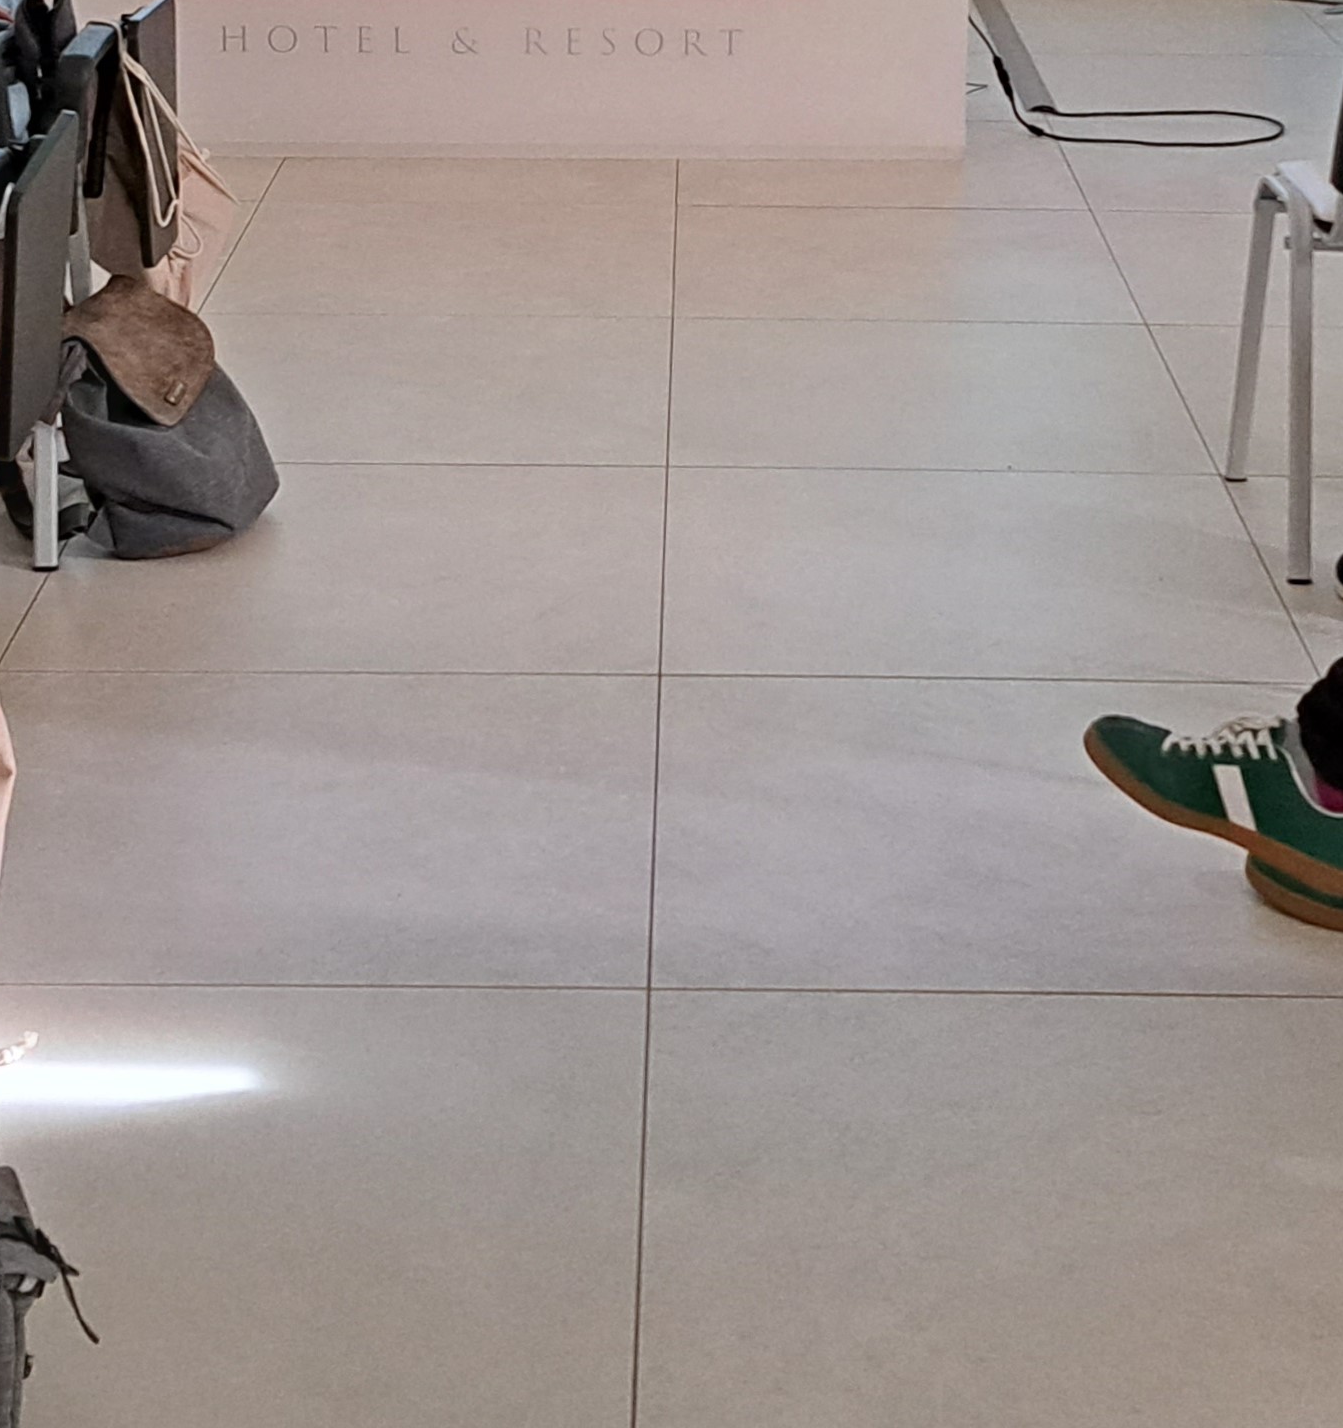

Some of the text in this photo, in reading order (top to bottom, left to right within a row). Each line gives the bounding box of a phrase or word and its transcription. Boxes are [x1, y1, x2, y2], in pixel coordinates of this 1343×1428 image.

[220, 24, 743, 59] HOTEL & RESORT
